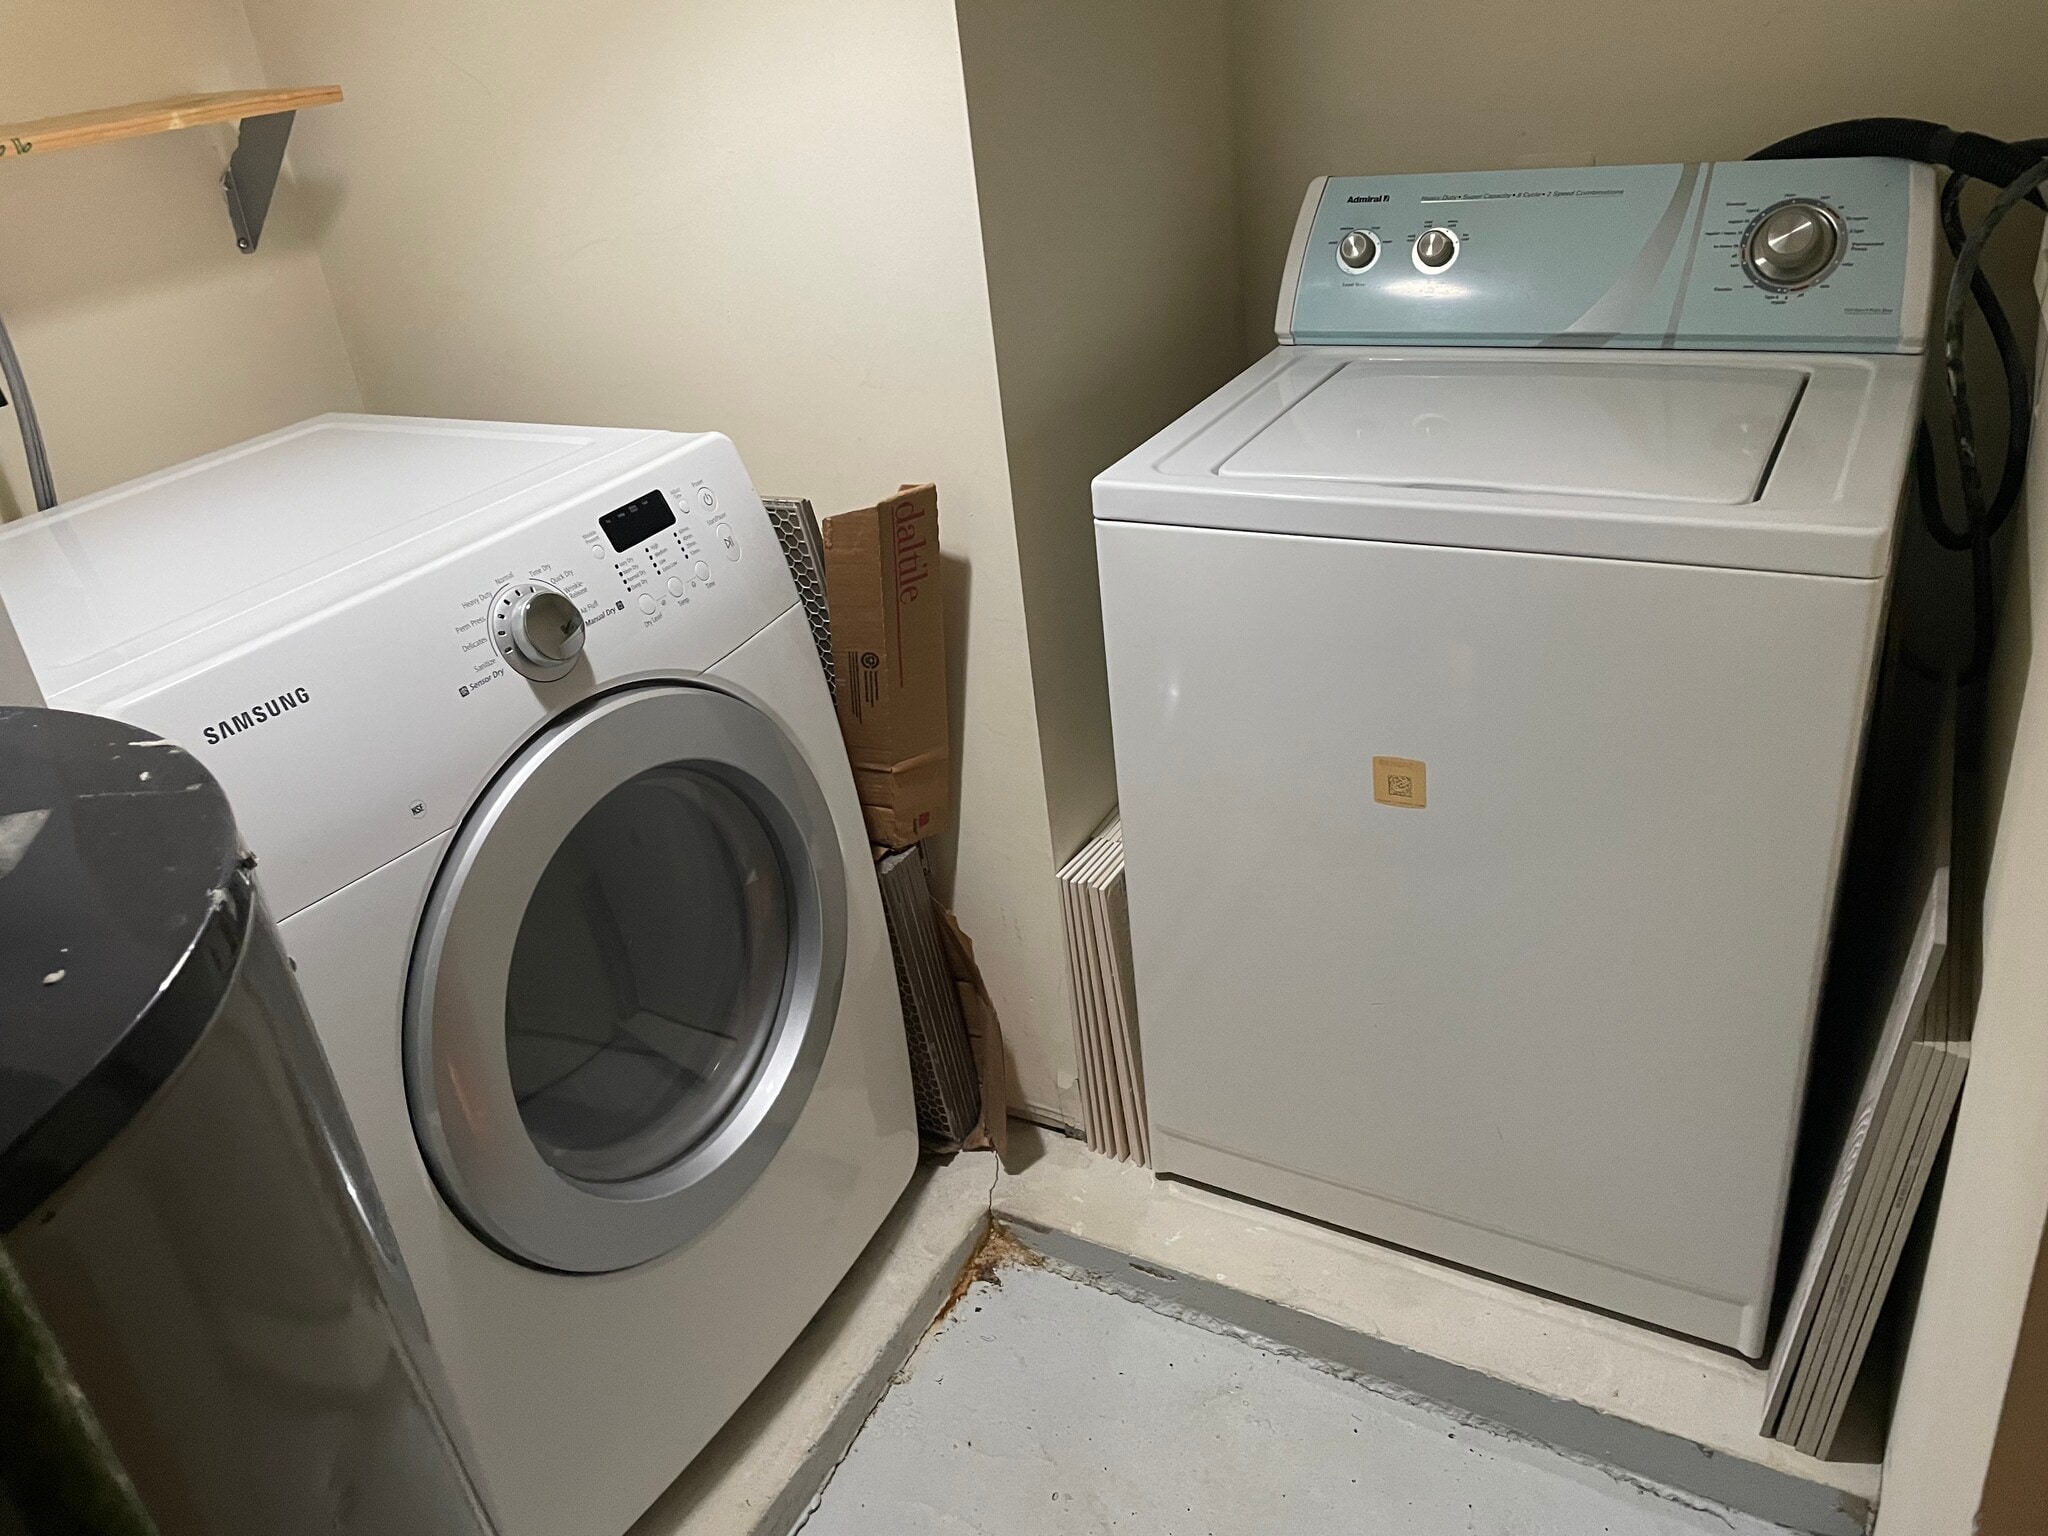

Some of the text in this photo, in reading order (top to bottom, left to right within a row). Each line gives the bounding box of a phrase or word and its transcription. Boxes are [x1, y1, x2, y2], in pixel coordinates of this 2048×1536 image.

[1347, 195, 1382, 203] Admiral
[896, 501, 929, 604] daltile
[495, 572, 514, 585] Normal
[529, 564, 552, 577] Time Dry
[563, 570, 574, 579] Dry
[462, 592, 493, 610] Heavy Duty
[585, 607, 617, 626] Manual Dry
[456, 617, 486, 634] Perm Press
[462, 637, 488, 653] Delicates
[474, 658, 497, 672] Sanitize
[469, 668, 505, 691] Sensor Dry
[203, 687, 310, 744] SAMSUNG
